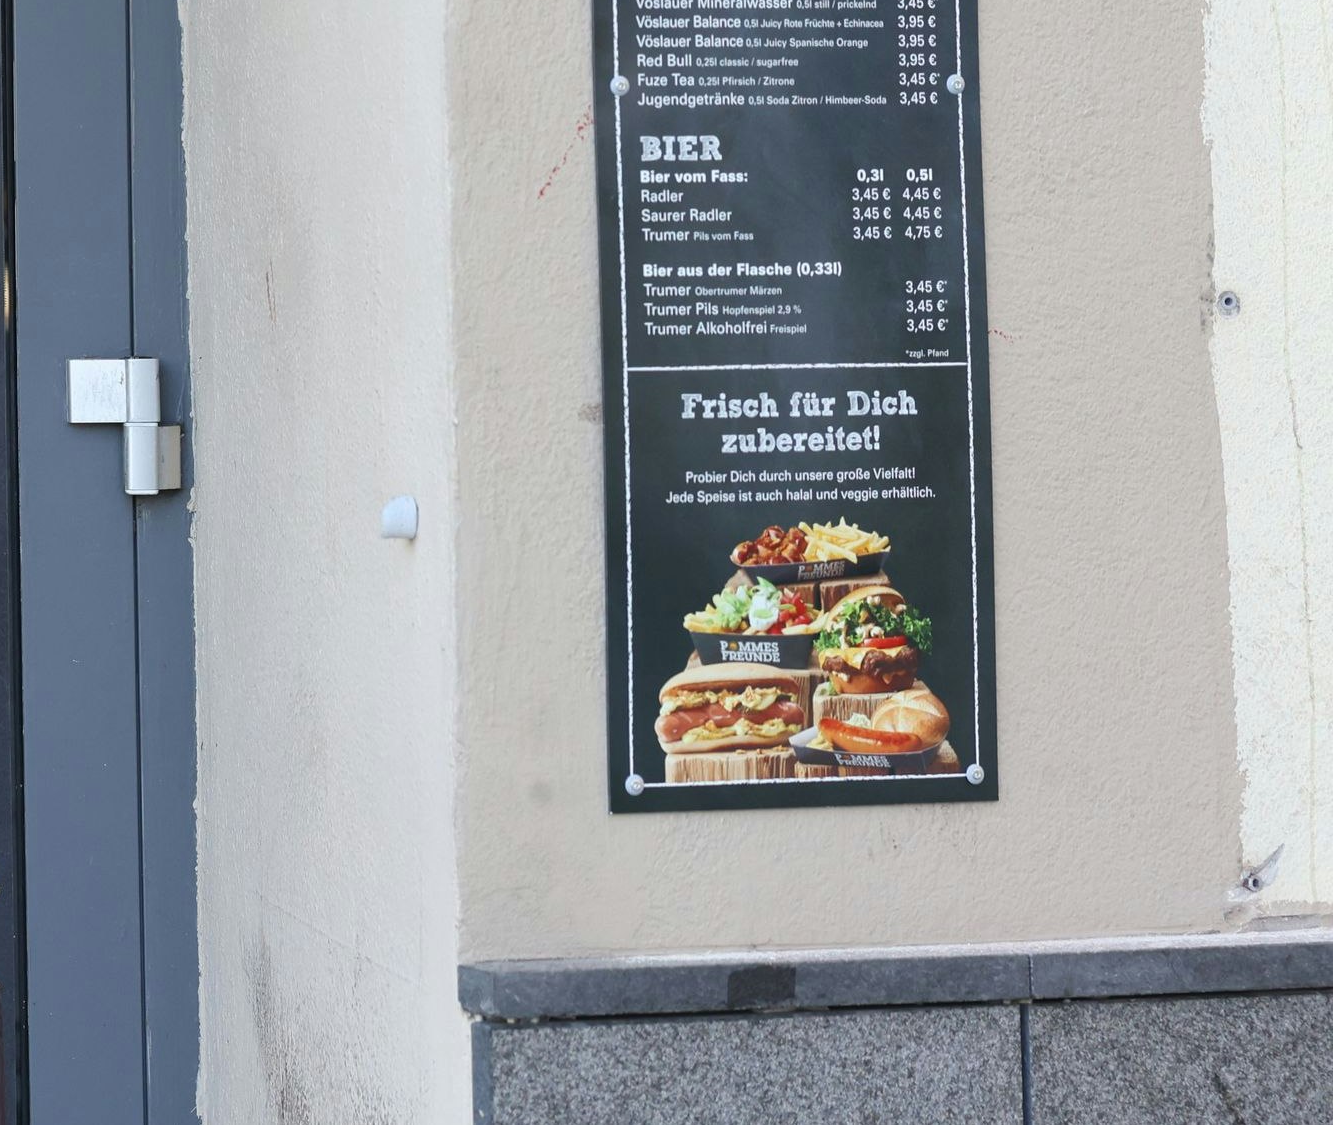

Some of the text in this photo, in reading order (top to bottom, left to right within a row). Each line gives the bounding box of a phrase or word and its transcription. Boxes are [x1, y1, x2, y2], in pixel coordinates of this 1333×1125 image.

[639, 134, 722, 162] BIER
[639, 169, 670, 183] Bier
[710, 169, 748, 183] Fass:
[856, 167, 933, 183] 0,3l 0,5l
[641, 207, 732, 222] Saurer Radler
[680, 389, 918, 419] Frisch für Dich
[720, 424, 880, 453] zubereitet!
[685, 466, 915, 484] Probier Dich durch unsere große Vielfalt!
[665, 485, 935, 505] Jede Speise ist auch halal und veggie erhältlich.
[721, 650, 780, 663] FREUNDE
